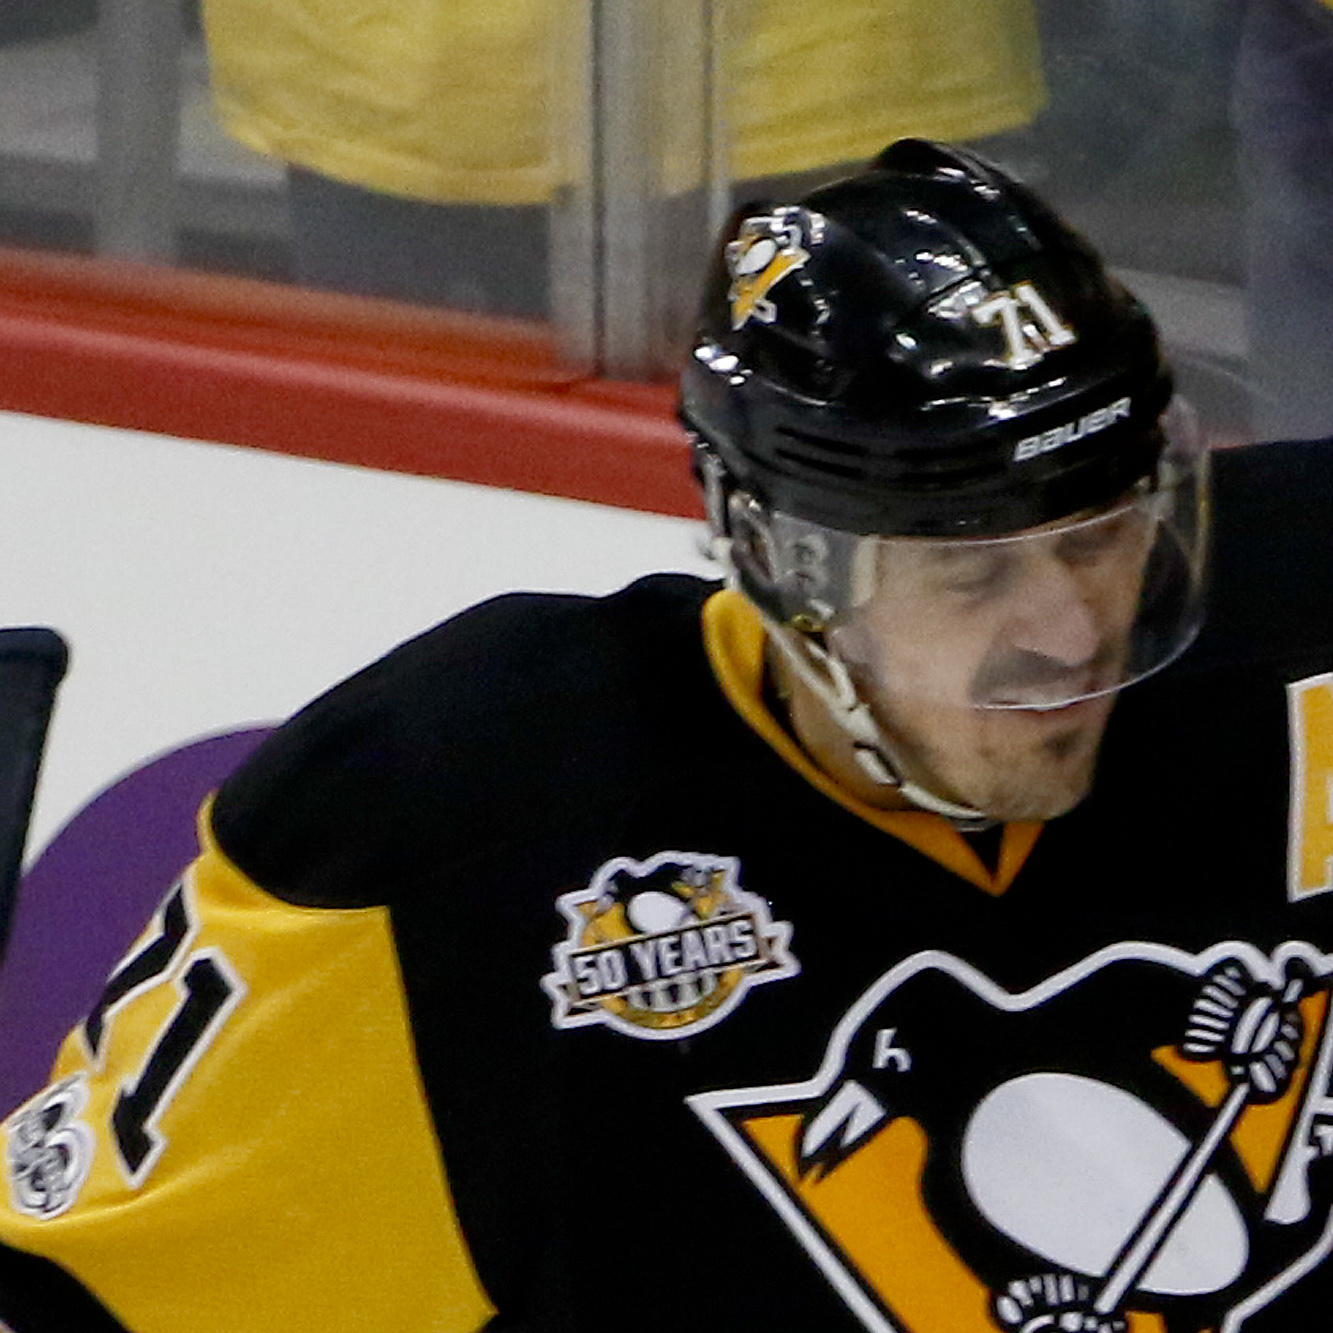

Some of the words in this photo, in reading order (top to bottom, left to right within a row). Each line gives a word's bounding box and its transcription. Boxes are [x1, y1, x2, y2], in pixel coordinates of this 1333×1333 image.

[972, 280, 1079, 370] 71
[1013, 397, 1132, 462] BAUER
[572, 950, 628, 996] 50
[630, 919, 758, 982] YEARS
